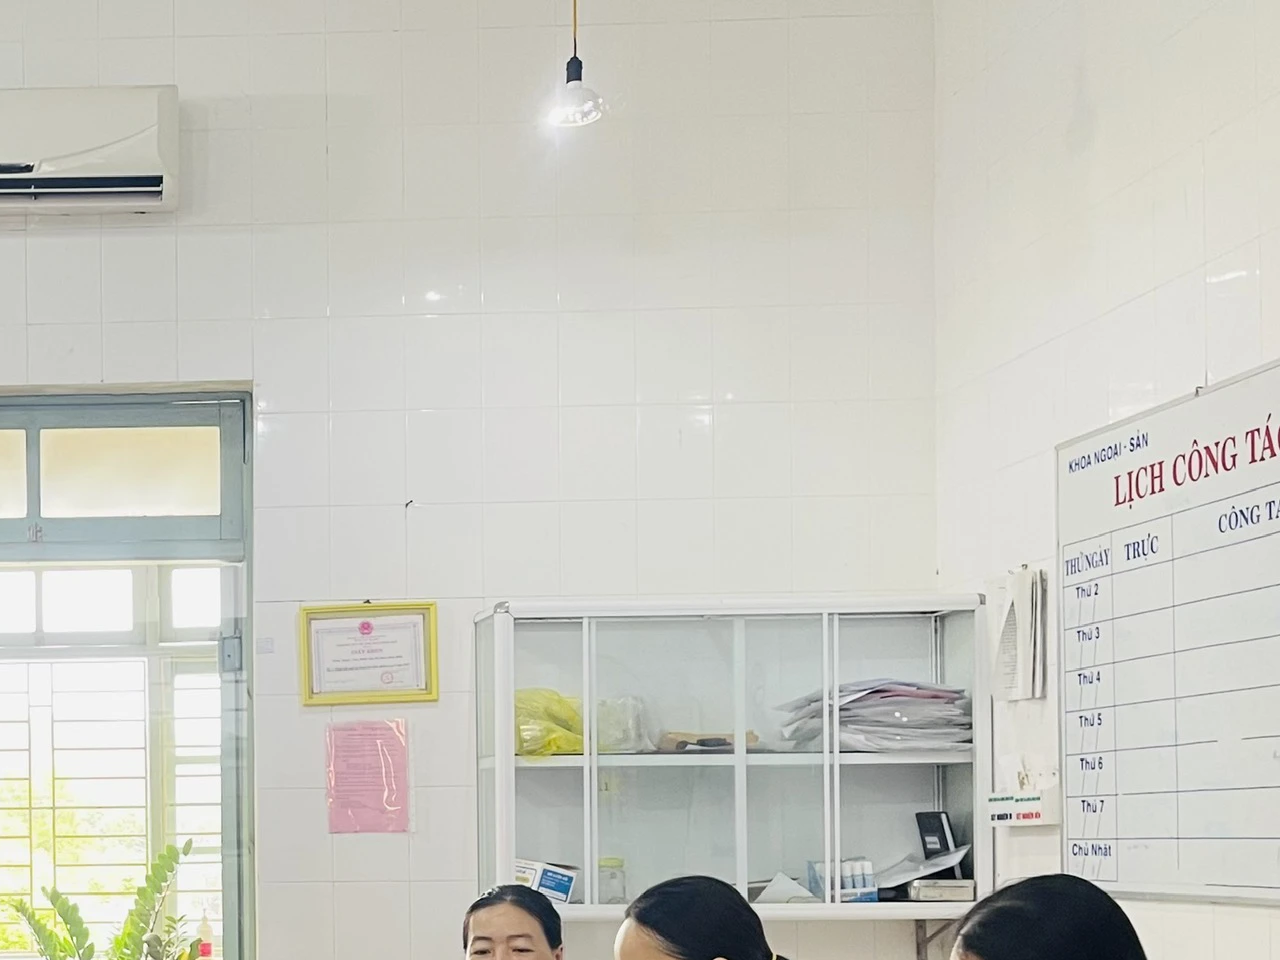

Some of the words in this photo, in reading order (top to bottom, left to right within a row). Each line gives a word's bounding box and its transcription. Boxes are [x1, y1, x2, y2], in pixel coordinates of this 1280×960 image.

[1069, 454, 1092, 473] KHOA
[1094, 442, 1121, 463] NGOẠI
[1114, 460, 1165, 509] LỊCH
[1172, 436, 1238, 487] CÔNG
[1245, 413, 1280, 464] TÁ
[1218, 505, 1261, 533] CÔNG
[1124, 533, 1159, 561] TRỰC
[1094, 583, 1099, 596] 2
[1095, 627, 1100, 639] 3
[1096, 671, 1101, 683] 4
[1097, 713, 1102, 726] 5
[1098, 756, 1103, 770] 6
[1099, 799, 1104, 813] 7
